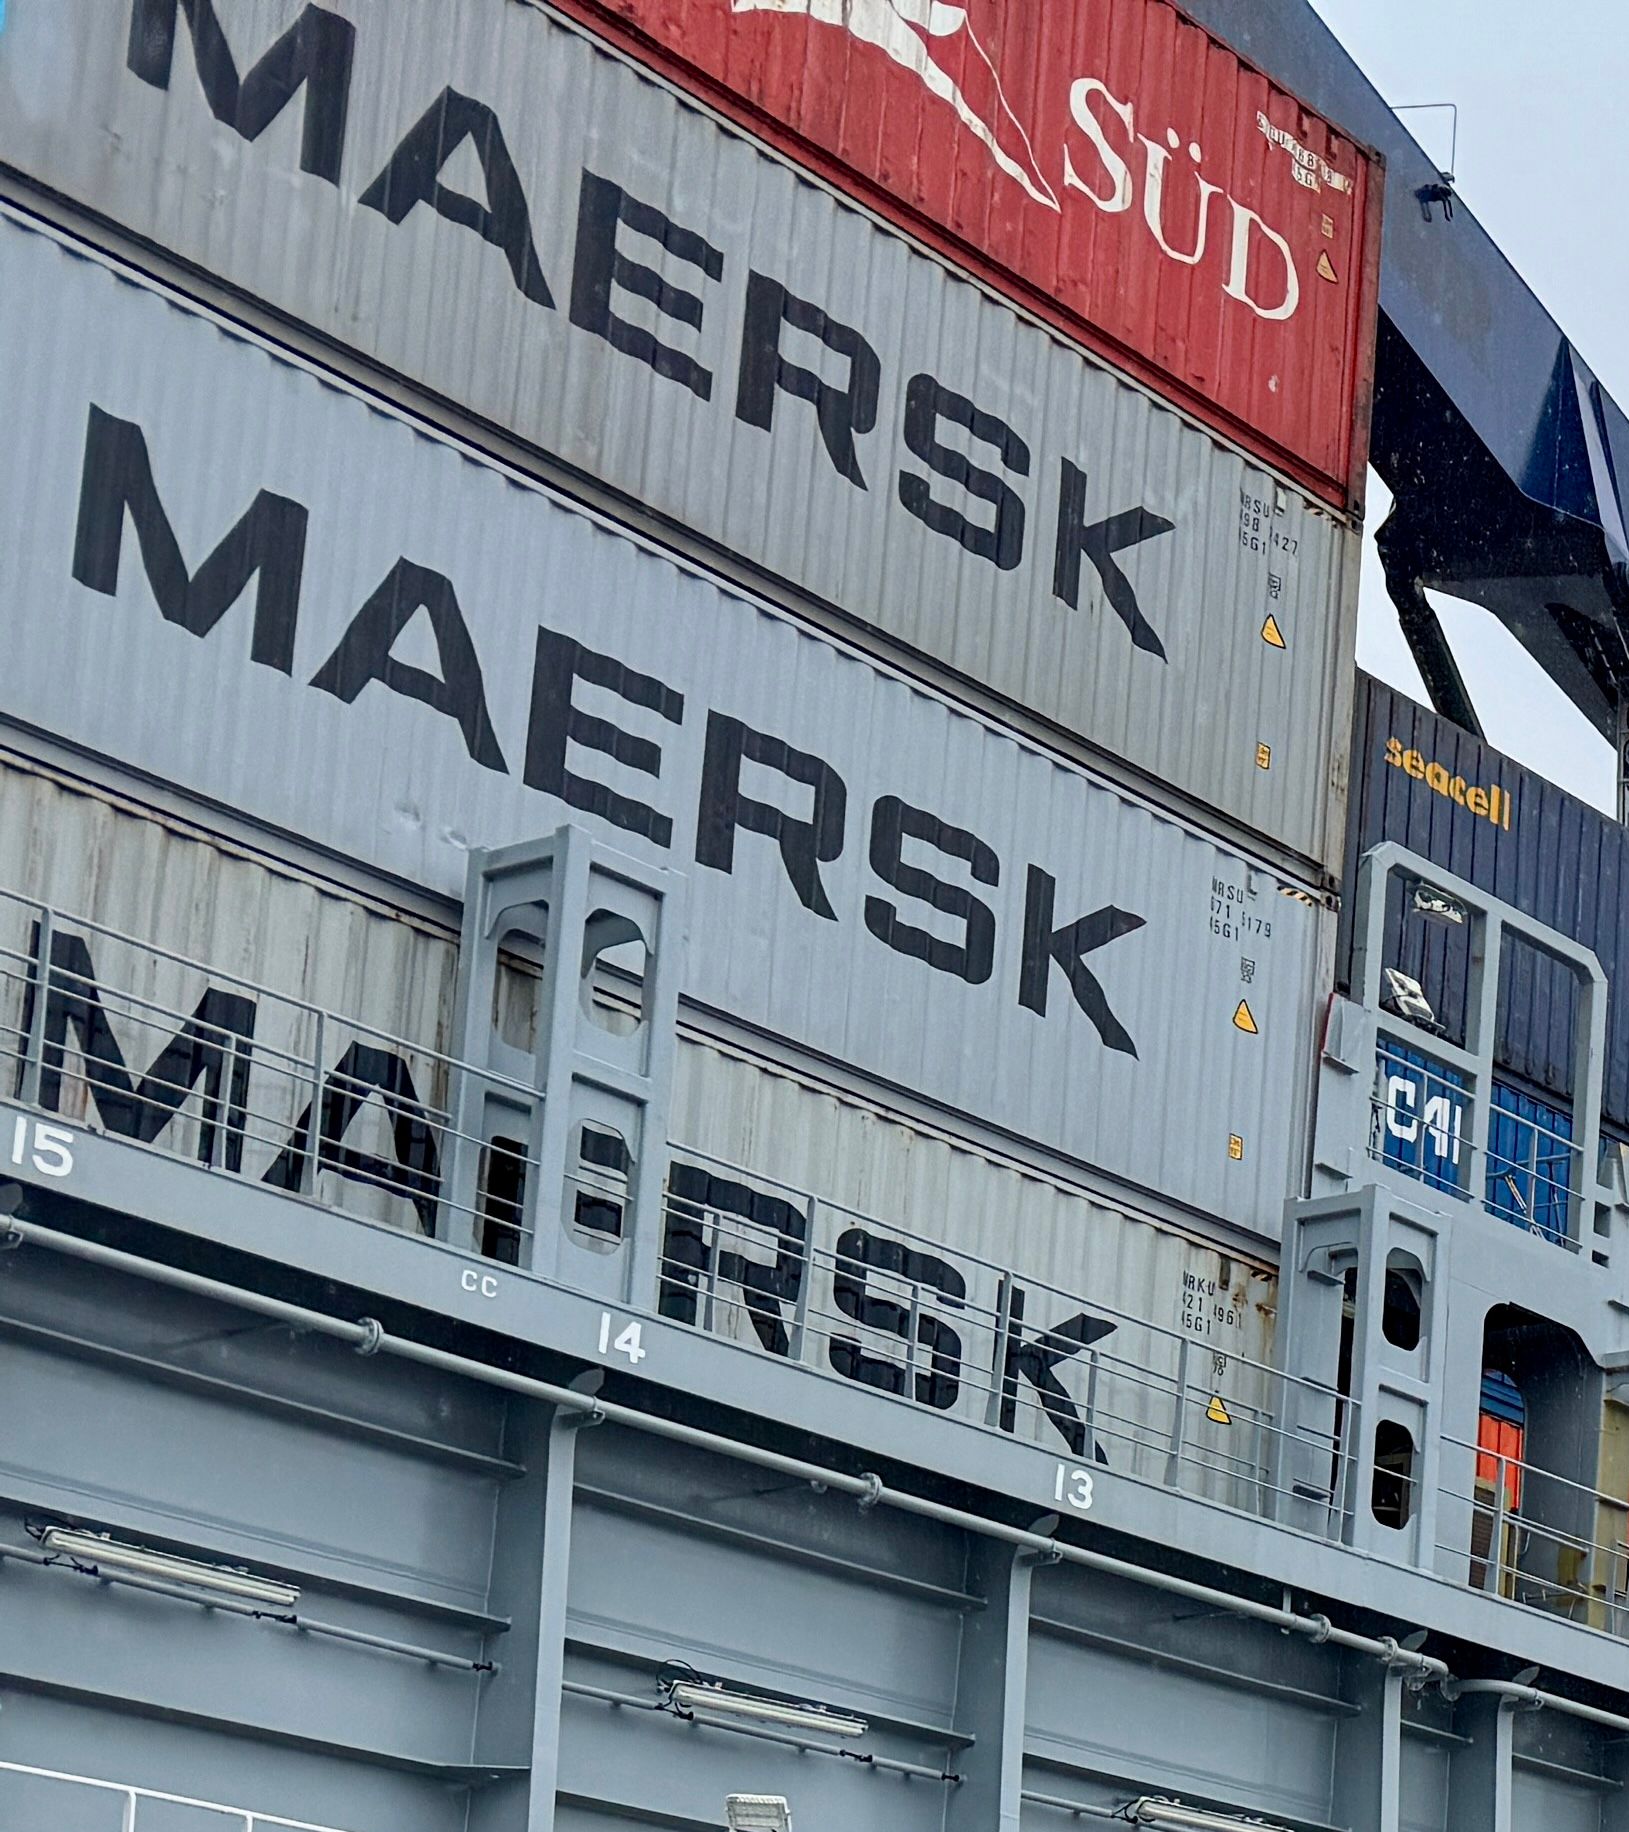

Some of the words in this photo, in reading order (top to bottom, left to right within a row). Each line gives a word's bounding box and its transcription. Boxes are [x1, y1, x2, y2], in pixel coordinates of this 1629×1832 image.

[1063, 76, 1300, 321] SÜD
[127, 0, 1177, 665] MAERSK
[72, 400, 1147, 1062] MAERSK
[1384, 736, 1510, 832] seacell
[12, 1117, 74, 1177] 15
[598, 1311, 646, 1365] 14
[1053, 1463, 1095, 1511] 13
